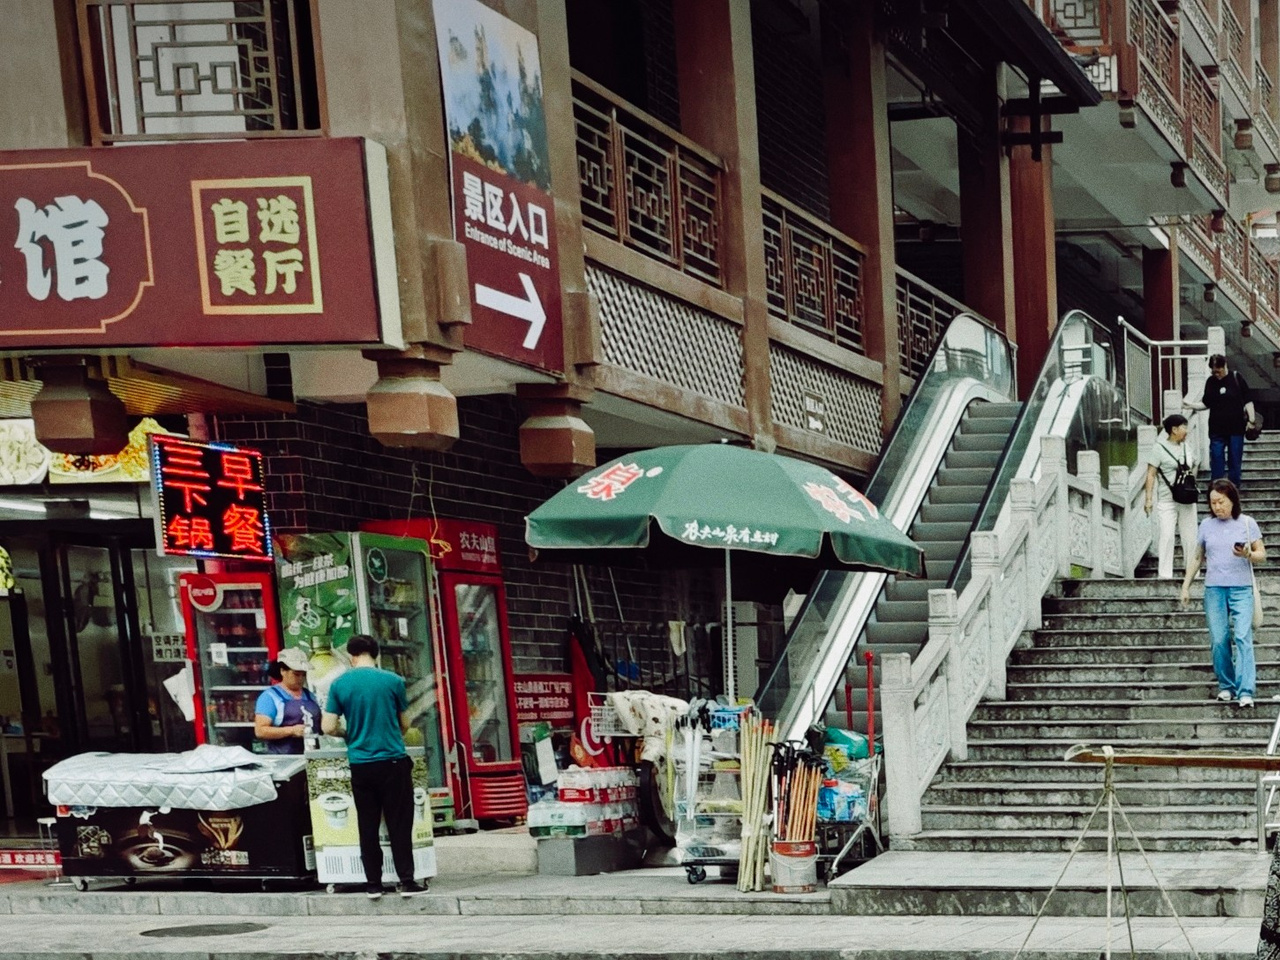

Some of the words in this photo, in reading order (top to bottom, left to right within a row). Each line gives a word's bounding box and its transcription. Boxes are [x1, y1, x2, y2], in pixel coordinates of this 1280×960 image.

[211, 194, 300, 244] 自选
[463, 171, 549, 250] 景区入口
[14, 195, 110, 301] 馆
[465, 221, 498, 249] Entrance
[499, 238, 507, 252] of
[507, 239, 533, 262] Scenic
[533, 250, 551, 269] Area
[214, 248, 304, 296] 餐厅
[161, 446, 214, 550] 三下锅
[217, 453, 264, 553] 早餐
[459, 531, 496, 552] 农夫山泉
[682, 519, 779, 546] 农夫山泉有点甜
